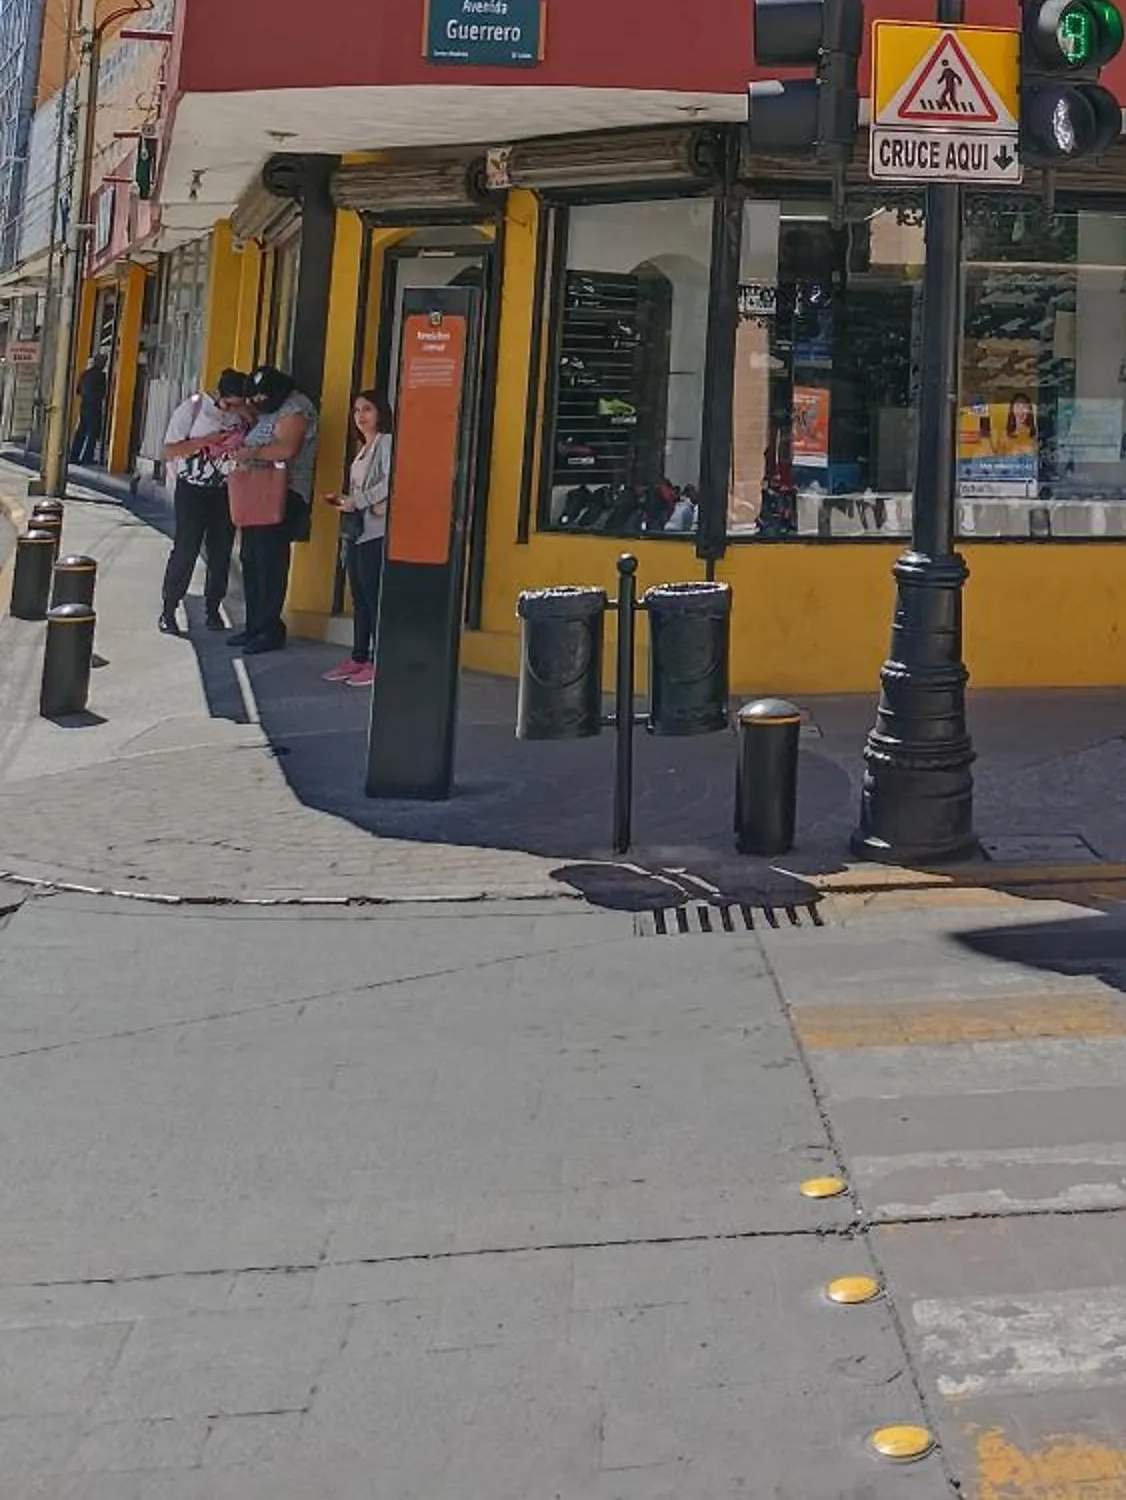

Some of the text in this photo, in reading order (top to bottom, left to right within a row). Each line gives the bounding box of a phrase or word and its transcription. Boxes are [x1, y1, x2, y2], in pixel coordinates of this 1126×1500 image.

[446, 19, 521, 41] Guerrero
[879, 139, 989, 172] CRUCE AQUI
